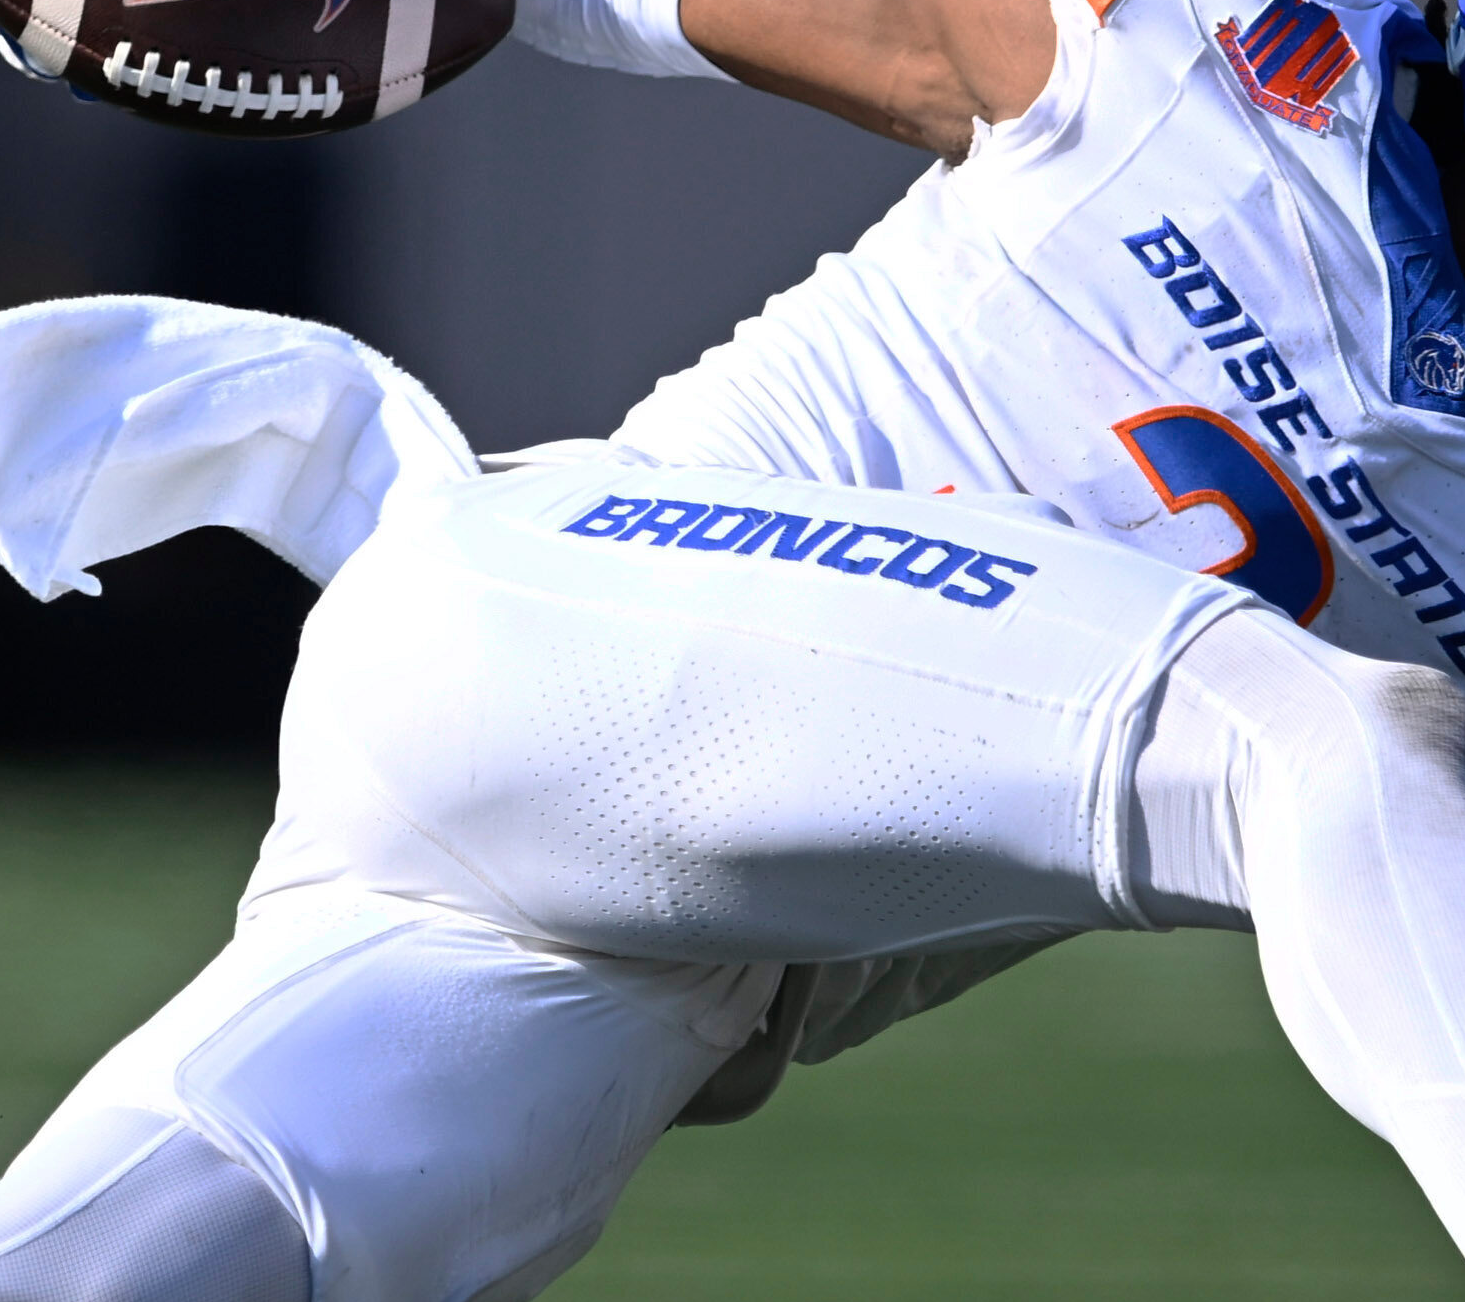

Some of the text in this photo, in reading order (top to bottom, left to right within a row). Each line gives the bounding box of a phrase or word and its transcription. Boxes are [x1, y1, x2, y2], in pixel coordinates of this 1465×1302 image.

[1222, 38, 1313, 126] GRADUATE
[1120, 213, 1335, 454] BOISE
[559, 494, 1039, 610] BRONCOS
